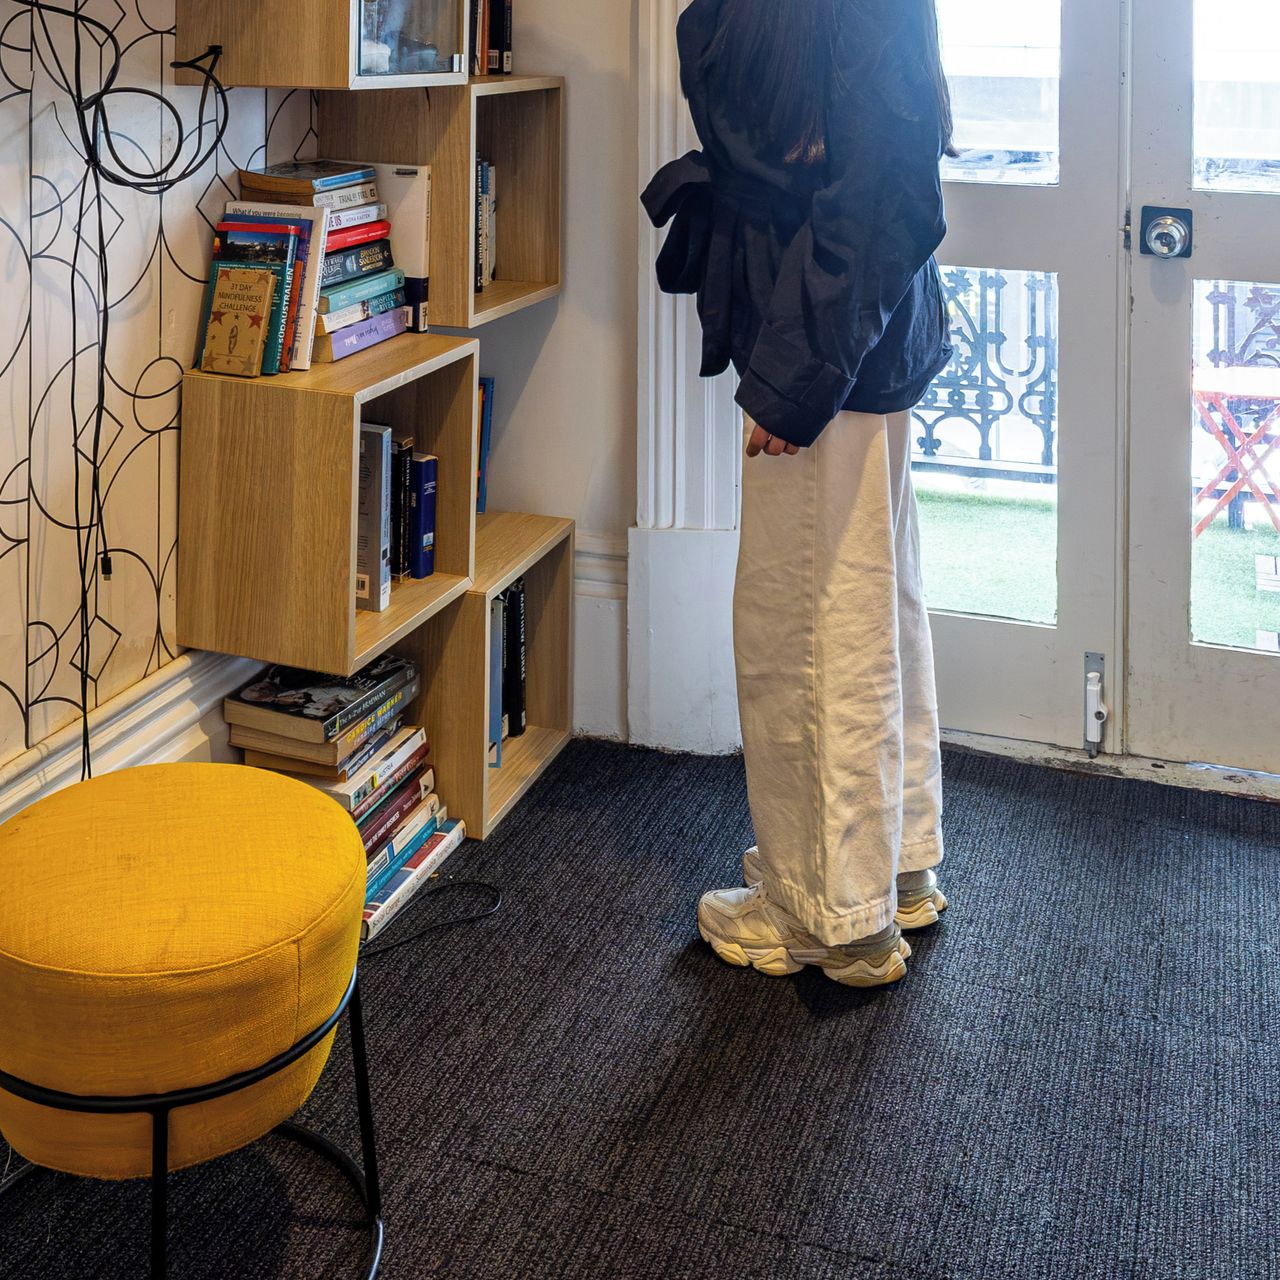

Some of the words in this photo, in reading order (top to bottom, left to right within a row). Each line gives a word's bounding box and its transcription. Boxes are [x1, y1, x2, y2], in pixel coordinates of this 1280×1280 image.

[252, 210, 262, 218] you
[230, 282, 239, 291] 31
[238, 283, 254, 293] DAY
[218, 292, 263, 304] MINDFULNESS
[219, 301, 257, 313] CHALLENGE
[278, 267, 295, 346] SÜDAUSTRALIEN
[346, 713, 376, 743] CANDICE
[376, 692, 403, 719] WARNER
